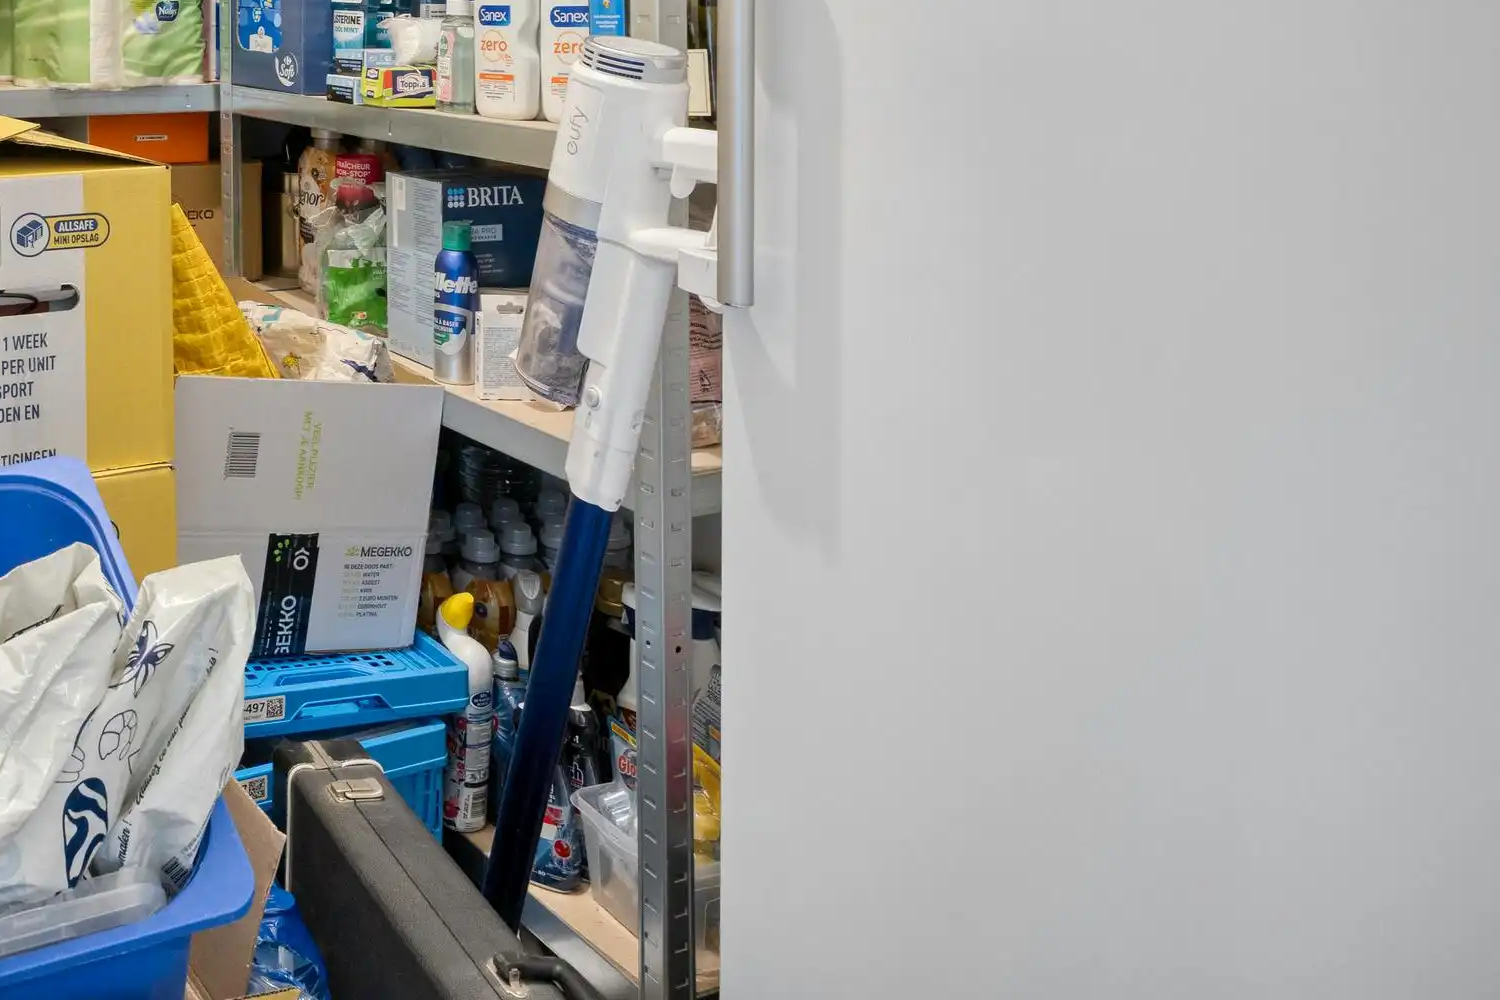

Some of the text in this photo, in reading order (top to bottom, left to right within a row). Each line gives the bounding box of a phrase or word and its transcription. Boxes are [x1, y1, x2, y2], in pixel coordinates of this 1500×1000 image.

[480, 8, 507, 22] Sanex
[554, 10, 589, 23] Sanex
[480, 40, 508, 52] zero
[401, 80, 426, 89] Toppis
[567, 106, 589, 156] eufy
[468, 186, 524, 208] BRITA
[58, 219, 95, 233] ALLSAFE
[53, 232, 100, 245] MINI OPSLAG
[3, 336, 8, 352] 1
[12, 332, 48, 351] WEEK
[1, 359, 26, 377] PER
[29, 355, 56, 374] UNIT
[25, 404, 41, 421] EN
[361, 546, 412, 557] MEGEKKO
[618, 755, 637, 778] Glo
[119, 826, 130, 867] malen
